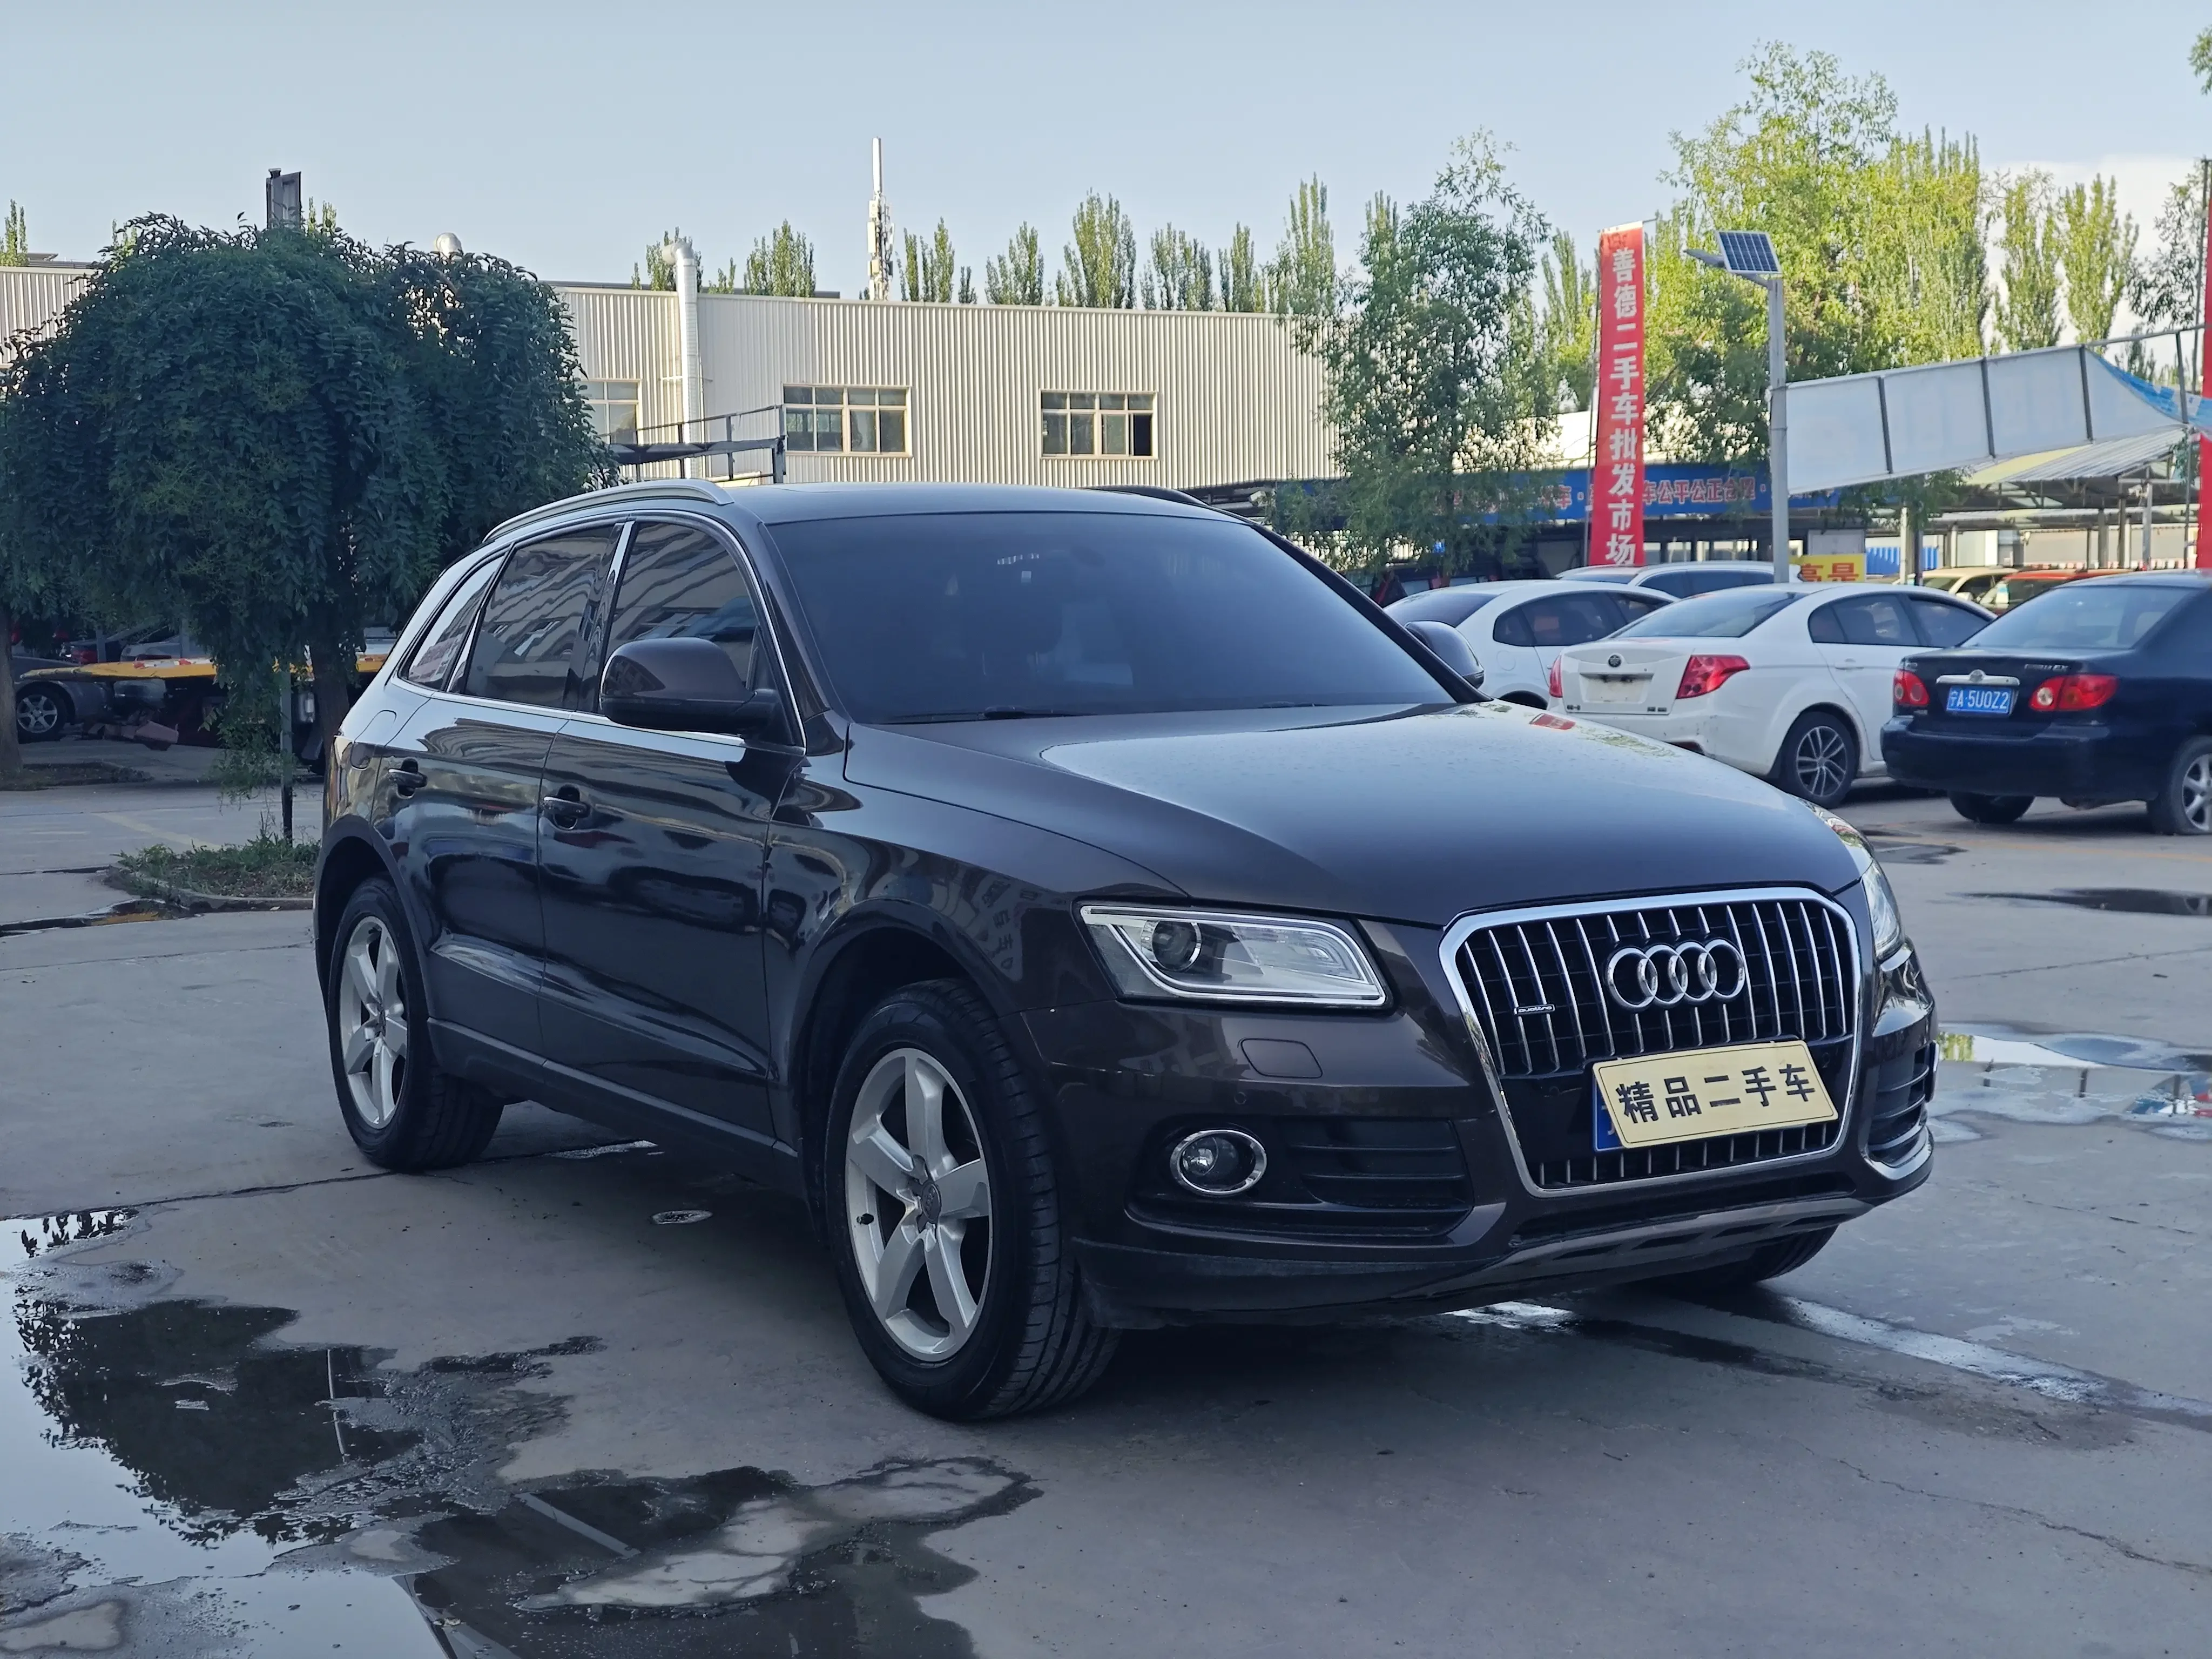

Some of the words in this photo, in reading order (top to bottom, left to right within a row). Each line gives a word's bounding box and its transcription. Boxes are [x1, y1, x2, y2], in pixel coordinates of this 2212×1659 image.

[1606, 247, 1640, 565] 善德二手车批发市场
[1615, 1063, 1816, 1124] 精品二手车
